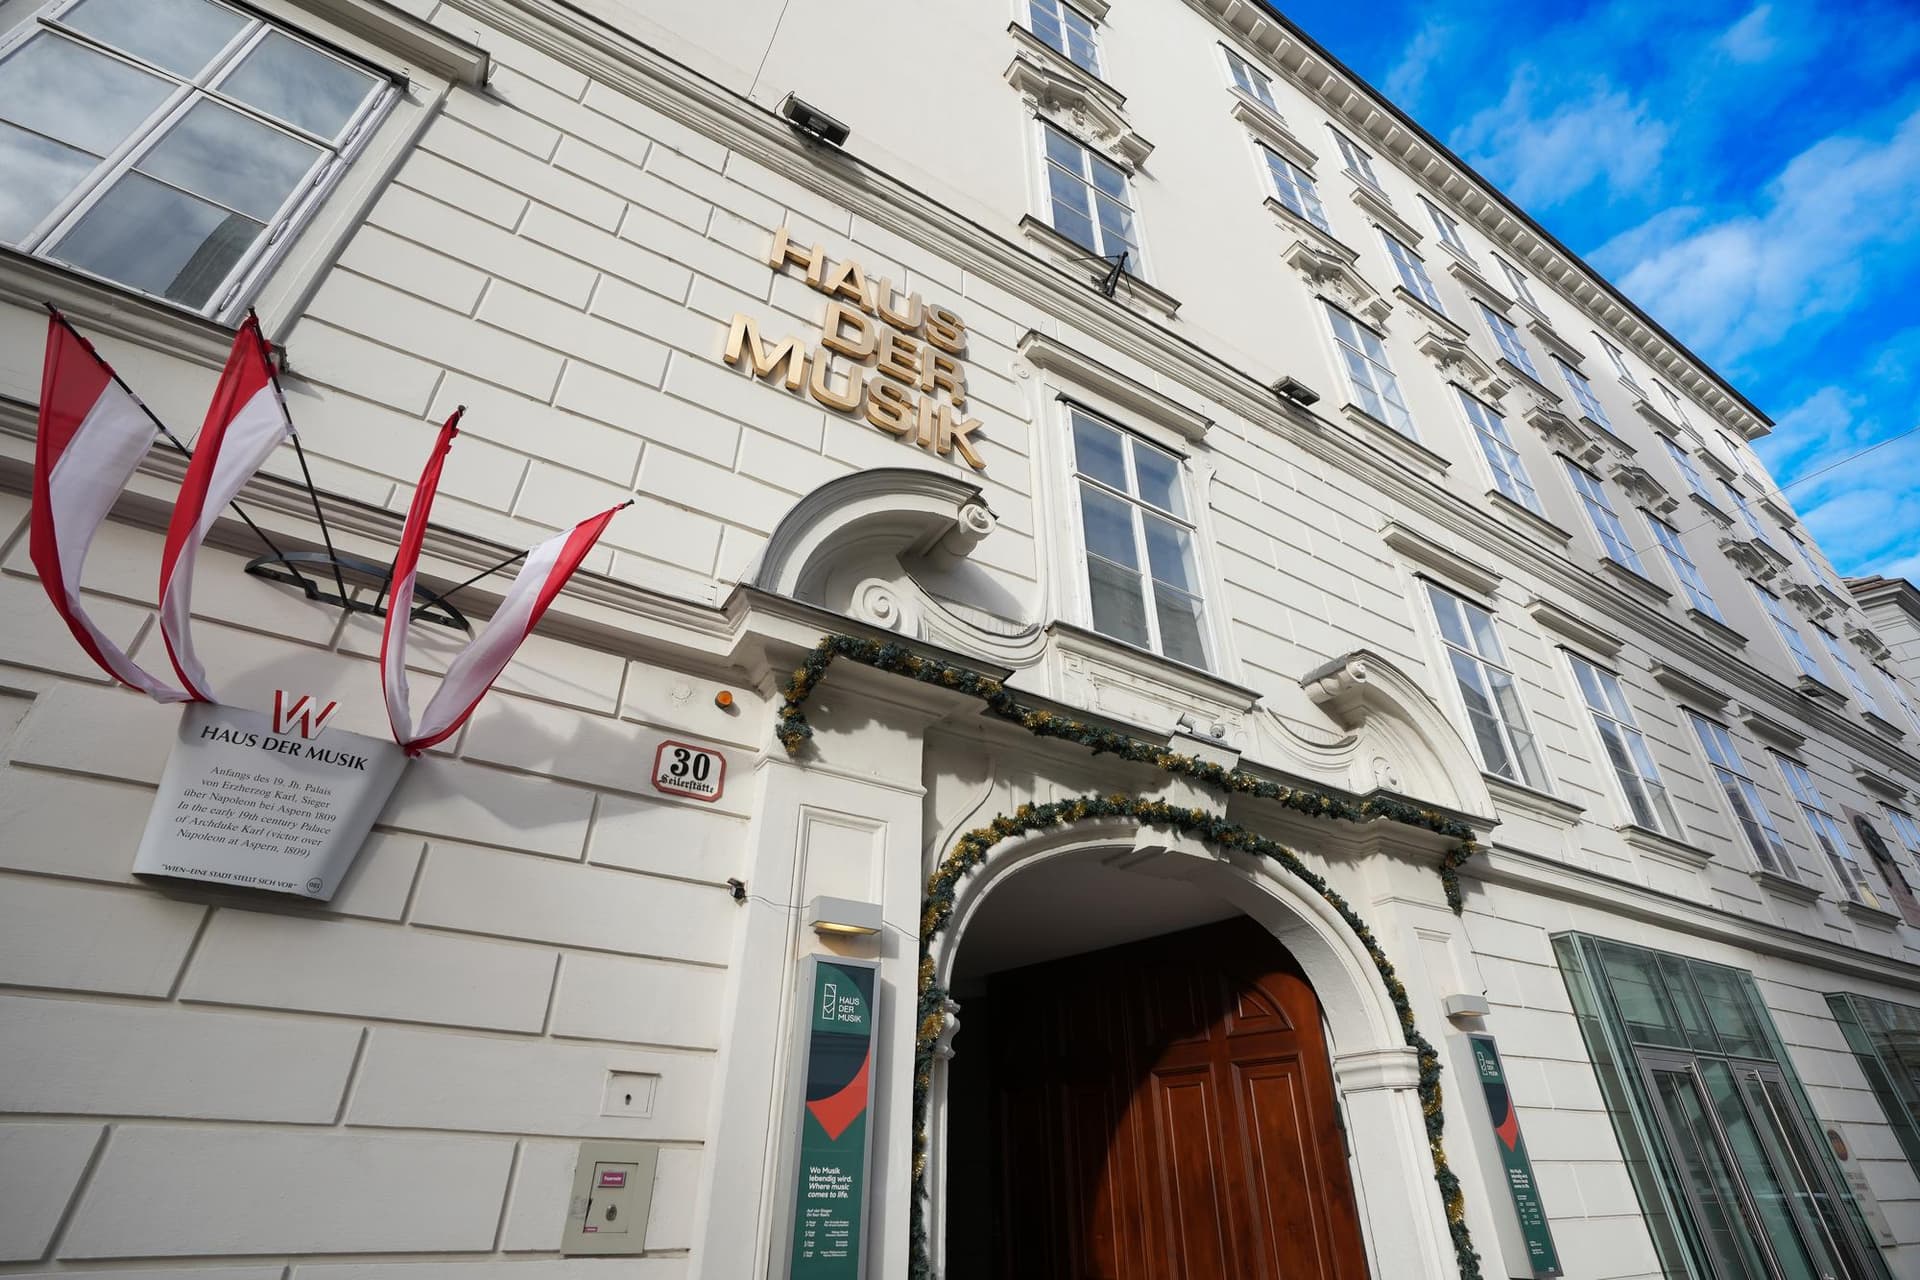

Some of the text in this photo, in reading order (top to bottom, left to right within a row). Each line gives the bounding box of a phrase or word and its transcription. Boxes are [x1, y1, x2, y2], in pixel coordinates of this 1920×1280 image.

[770, 227, 967, 353] HAUS
[821, 301, 967, 406] DER
[723, 311, 987, 470] MUSIK
[200, 724, 369, 771] HAUS DER MUSIK
[670, 748, 711, 781] 30
[202, 779, 219, 788] von
[222, 781, 271, 799] Erzherzog
[301, 796, 331, 809] Sieger
[209, 766, 332, 796] Anfangs des 19. Jh. Palais
[178, 801, 332, 834] In the early 19th century Palace
[184, 788, 337, 822] über Napoleon bei Aspern 1809
[176, 815, 324, 847] of Archduke Karl (victor over
[177, 828, 226, 844] Napoleon
[284, 846, 311, 858] 1809)
[210, 871, 233, 880] STADT
[259, 879, 276, 887] SICH
[838, 1005, 855, 1014] DER
[839, 996, 860, 1006] HAUS
[837, 1013, 862, 1023] MUSIK
[808, 1175, 853, 1185] lebendig wird.
[822, 1167, 841, 1175] Musik
[831, 1183, 850, 1191] music
[837, 1190, 849, 1199] life.
